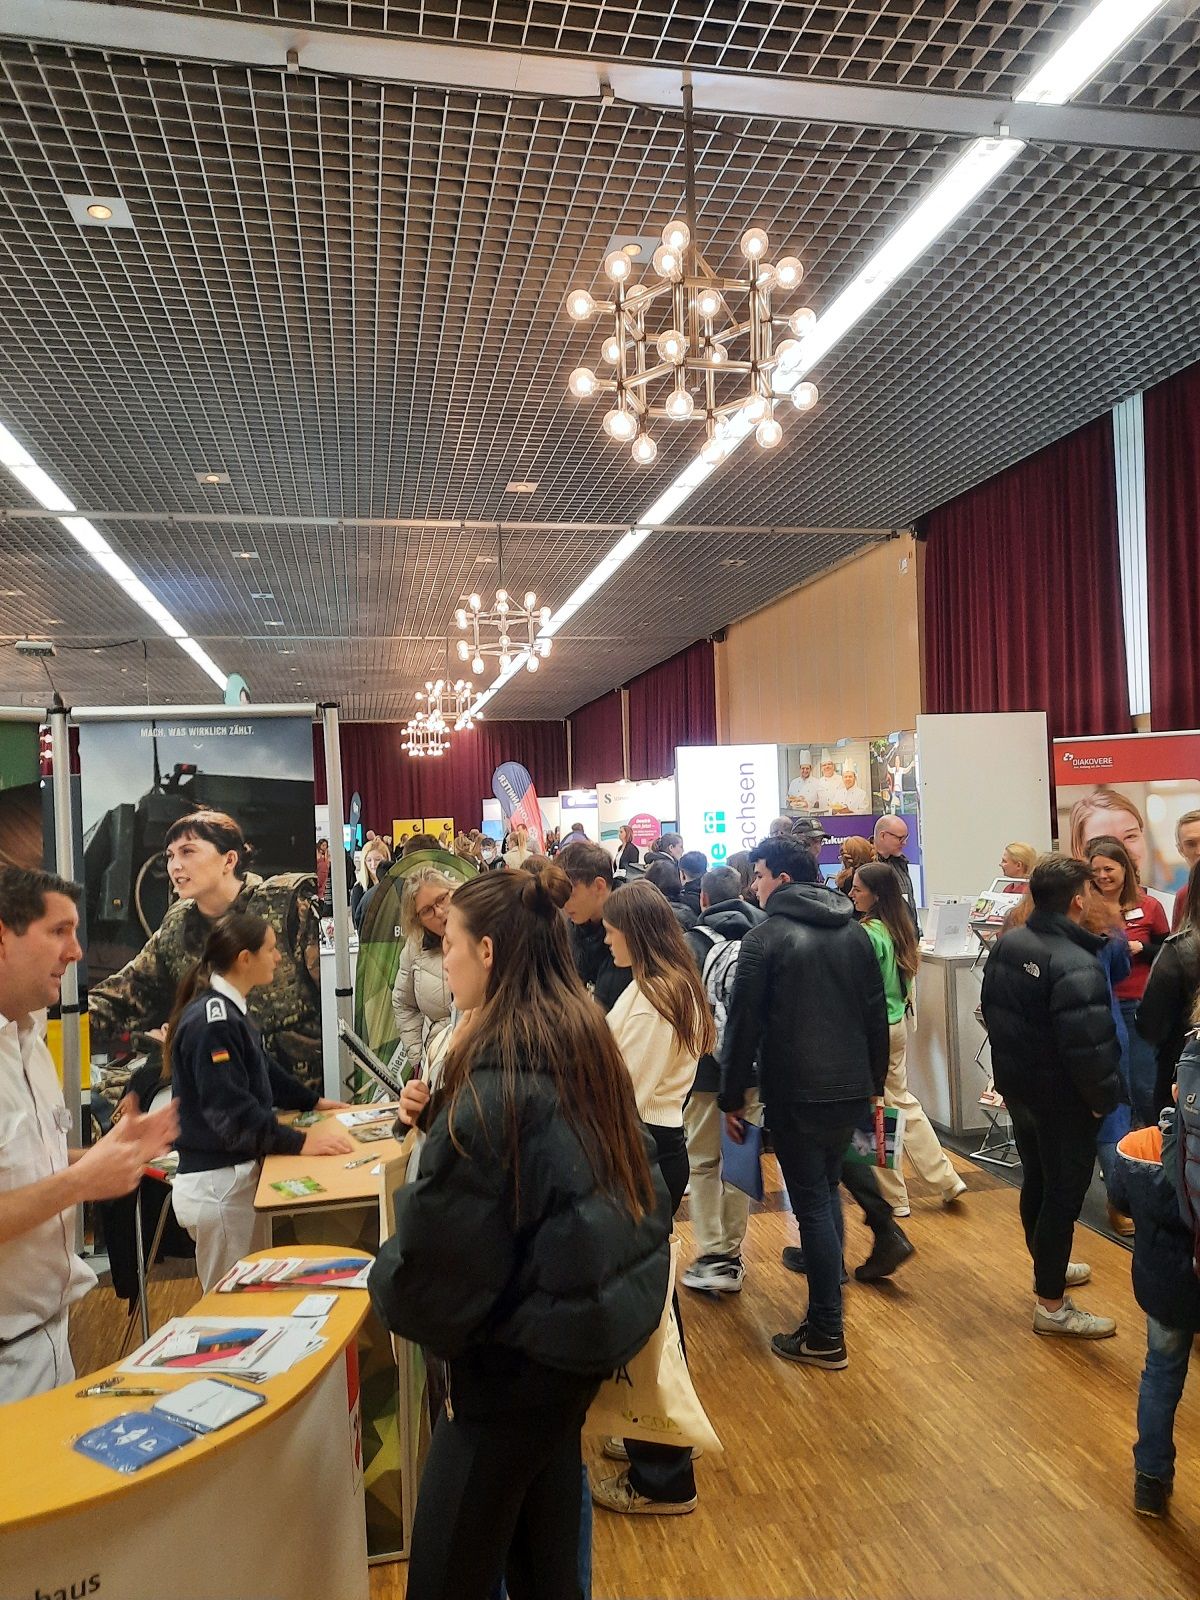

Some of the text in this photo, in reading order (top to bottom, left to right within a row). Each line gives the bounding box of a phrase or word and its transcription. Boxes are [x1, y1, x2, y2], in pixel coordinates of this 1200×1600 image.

[140, 724, 254, 737] MACH. WAS WIRKLICH ZÄHLT.
[1072, 757, 1113, 766] DIAKOVERE
